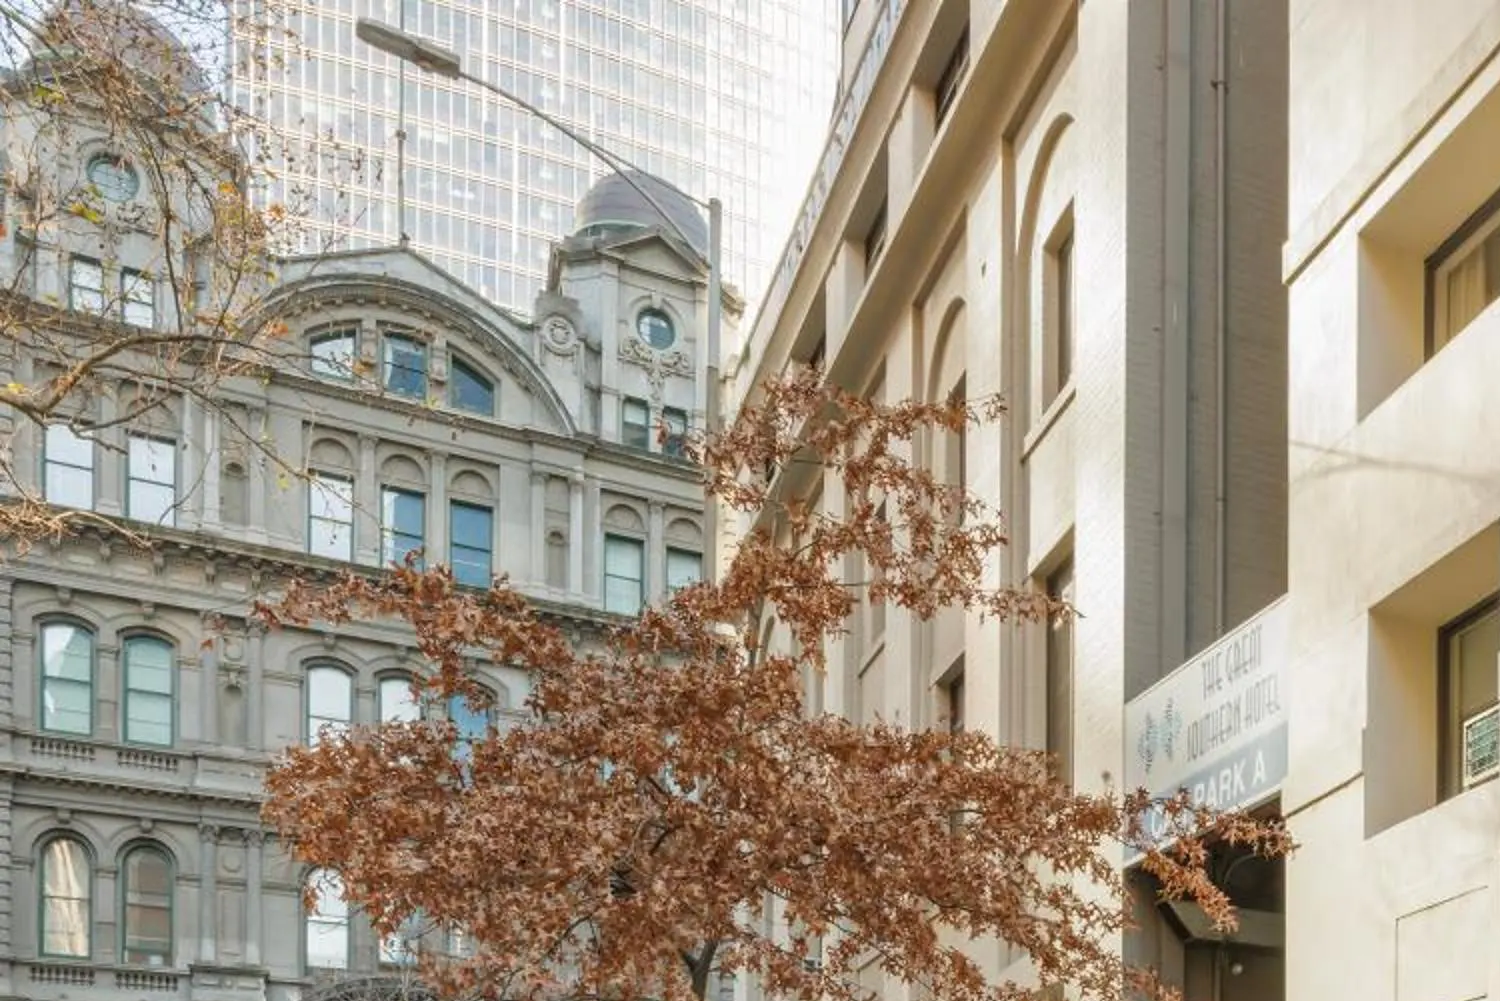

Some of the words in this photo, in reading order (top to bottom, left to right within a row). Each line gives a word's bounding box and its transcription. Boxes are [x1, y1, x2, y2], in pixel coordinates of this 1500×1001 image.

[1201, 650, 1223, 702] THE
[1225, 623, 1263, 686] GREAT
[1244, 671, 1281, 730] HOTEL
[1193, 758, 1246, 808] PARK
[1252, 749, 1268, 786] A
